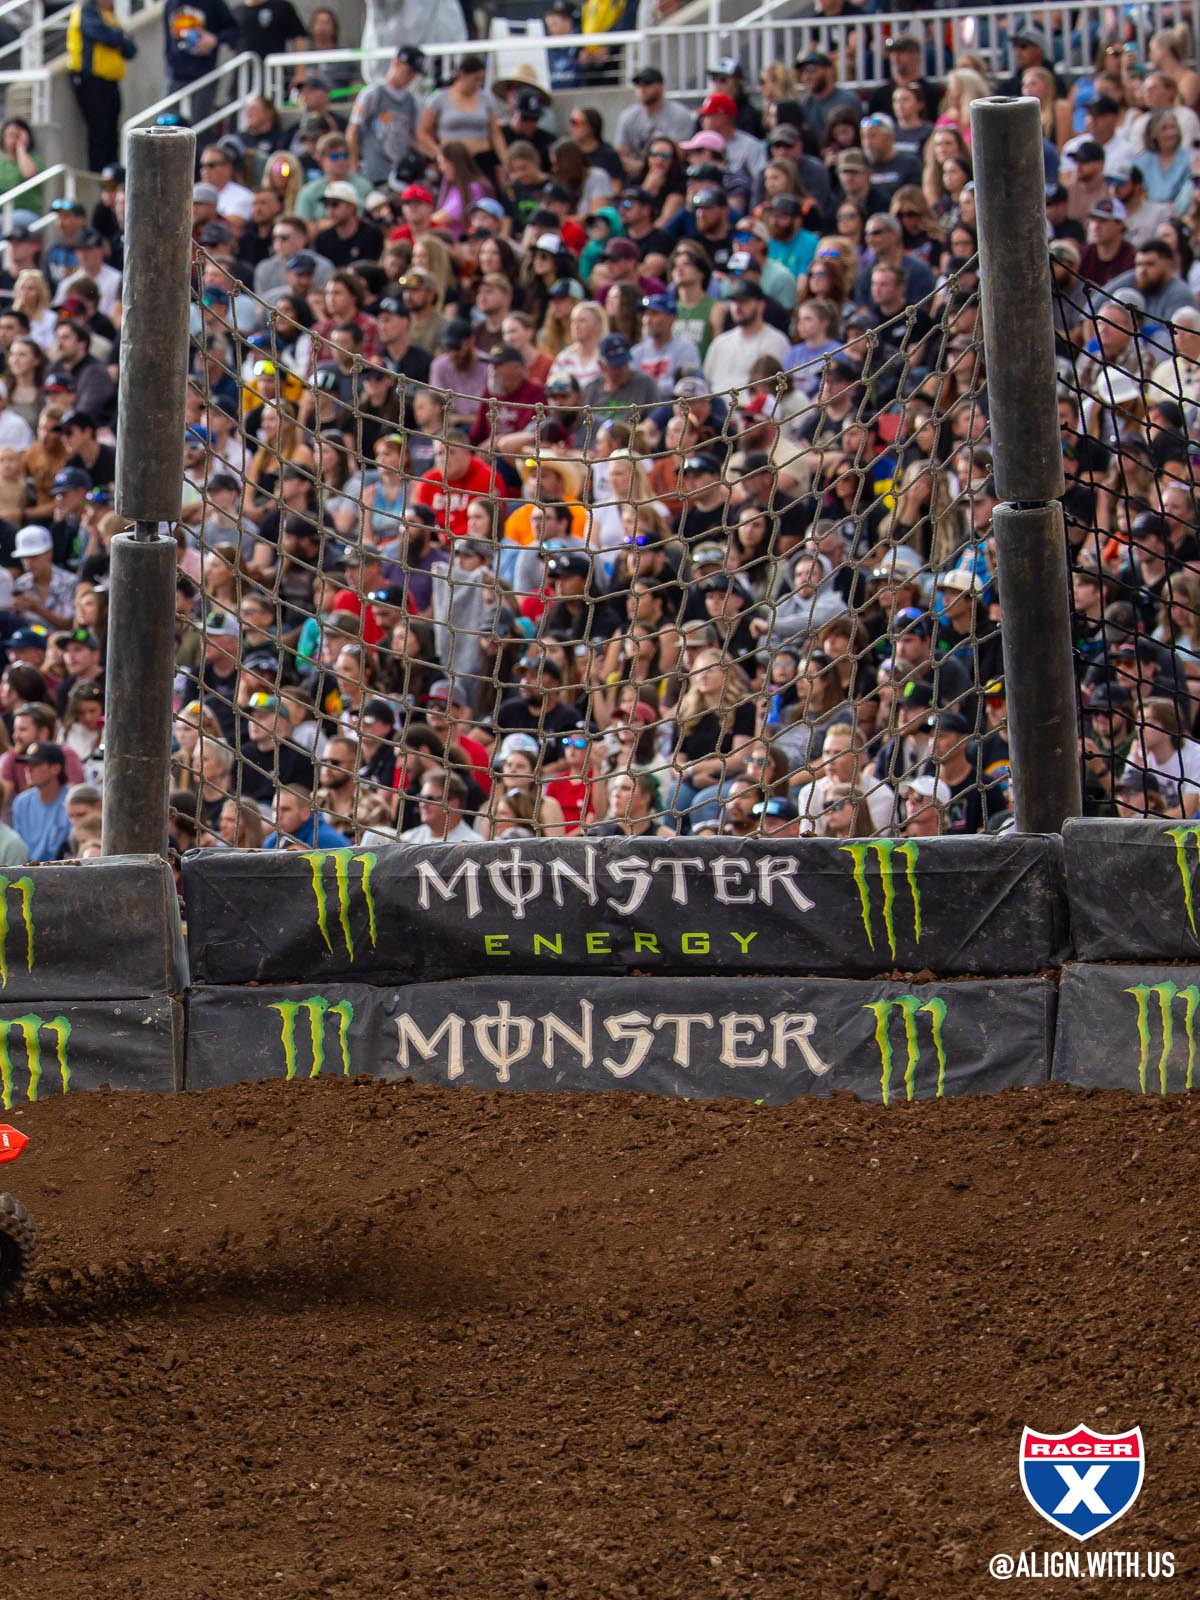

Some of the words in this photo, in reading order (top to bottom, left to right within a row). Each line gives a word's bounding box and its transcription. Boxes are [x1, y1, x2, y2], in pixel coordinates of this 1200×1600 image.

[415, 845, 817, 920] MONSTER
[484, 932, 759, 956] ENERGY
[394, 999, 834, 1083] MONSTER
